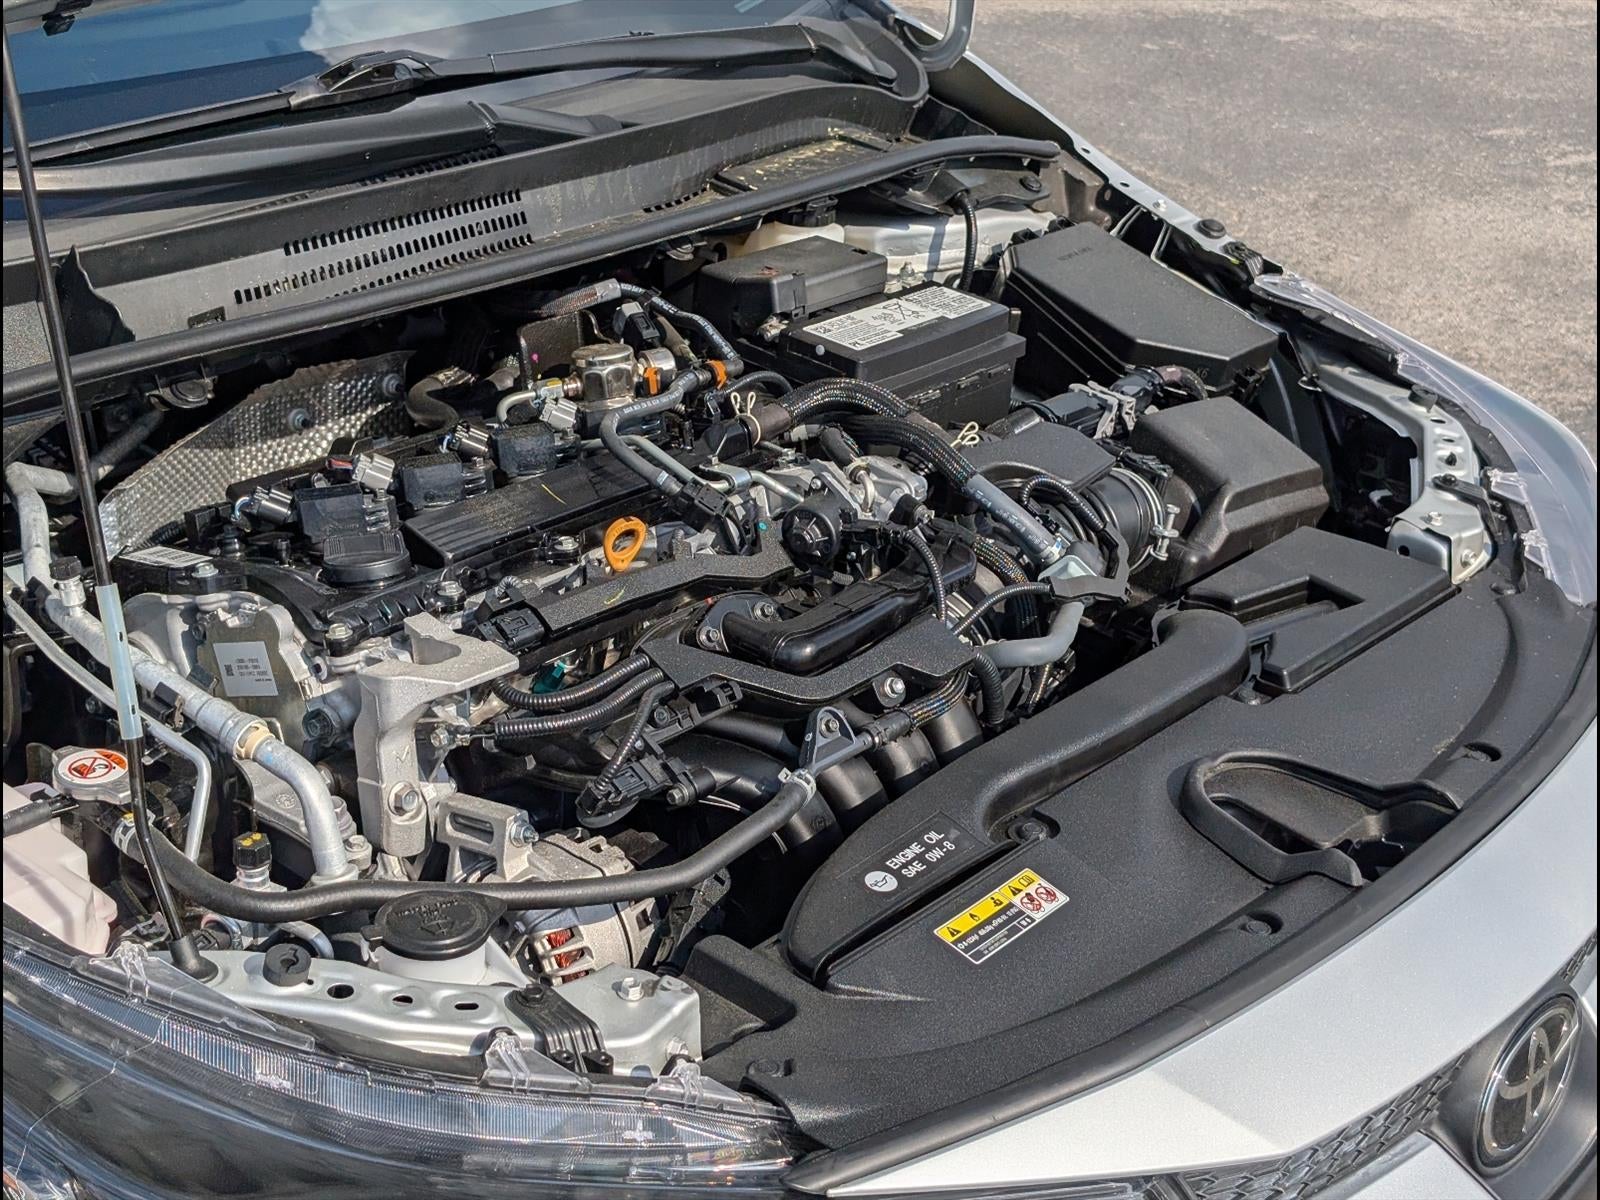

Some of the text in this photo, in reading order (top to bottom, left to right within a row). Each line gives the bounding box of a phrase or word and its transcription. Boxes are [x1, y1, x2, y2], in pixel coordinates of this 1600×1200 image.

[885, 830, 945, 869] ENGINE OIL
[901, 840, 956, 878] SAE 0W-8
